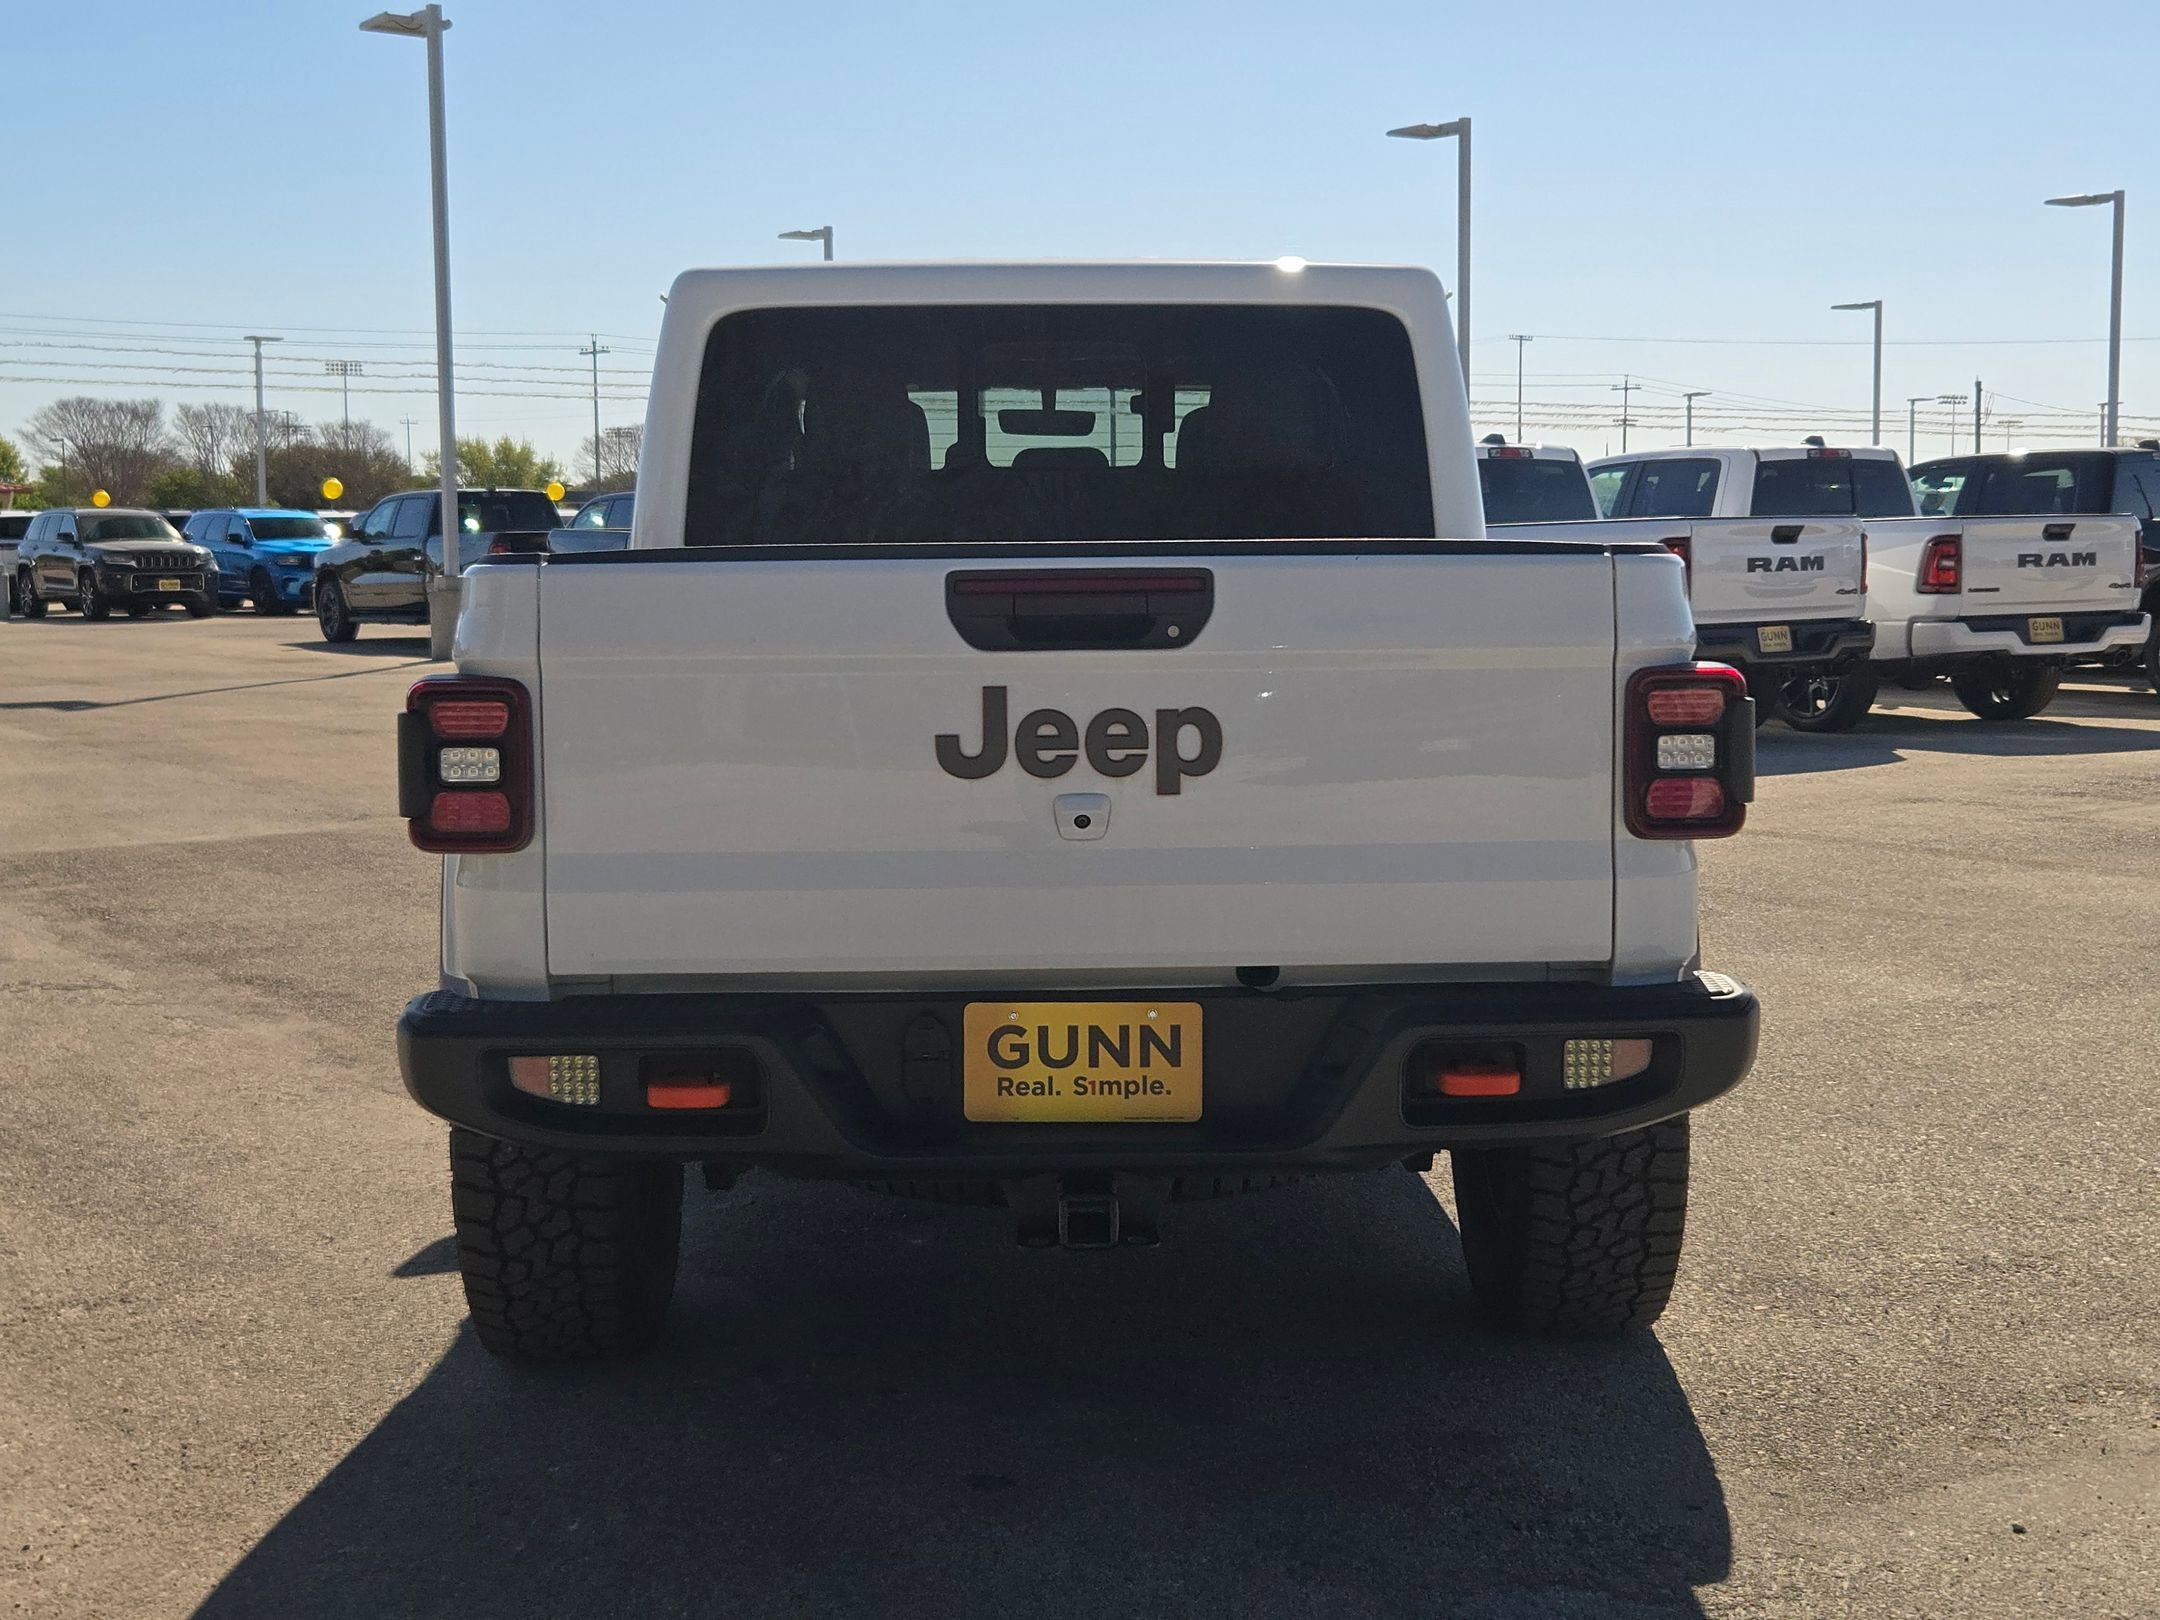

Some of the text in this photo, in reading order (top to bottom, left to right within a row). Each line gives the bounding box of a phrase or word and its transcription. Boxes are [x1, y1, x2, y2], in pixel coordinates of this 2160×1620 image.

[1746, 555, 1825, 573] RAM
[2017, 552, 2097, 568] RAM
[2031, 619, 2061, 633] GUNN
[1760, 630, 1789, 642] GUNN
[934, 685, 1223, 796] Jeep
[987, 1024, 1182, 1069] GUNN
[997, 1075, 1061, 1097] Real.
